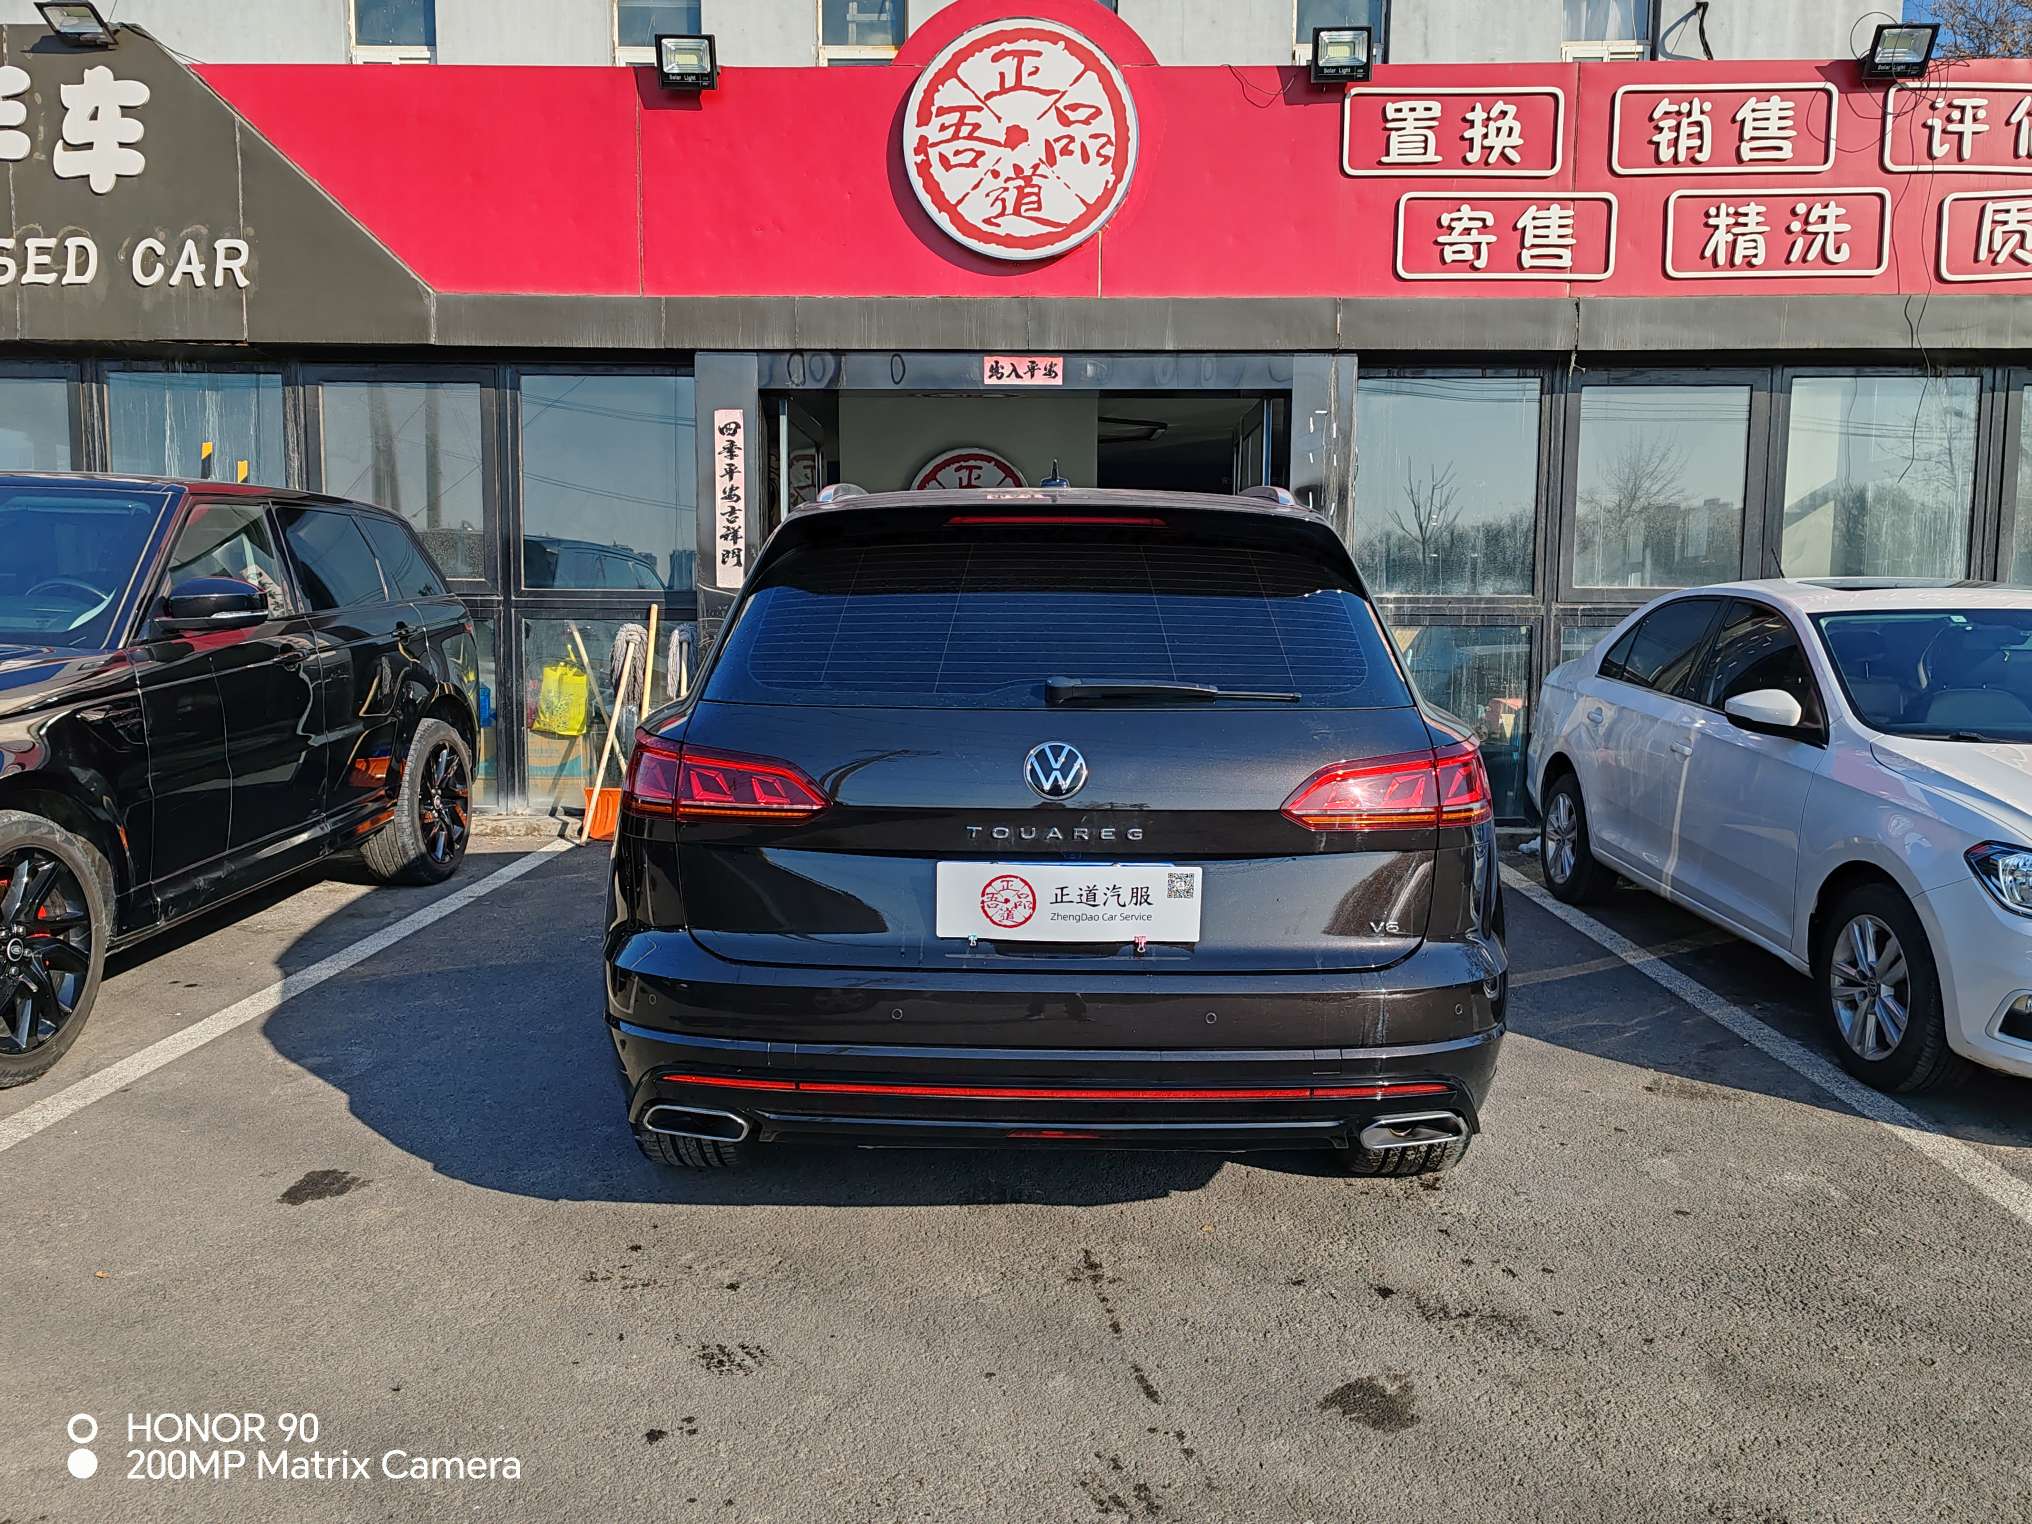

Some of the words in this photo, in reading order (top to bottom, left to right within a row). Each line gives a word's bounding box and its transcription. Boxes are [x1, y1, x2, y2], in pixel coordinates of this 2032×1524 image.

[1381, 101, 1523, 164] 置换
[1651, 96, 1797, 164] 销售
[1436, 204, 1577, 269] 寄售
[1704, 201, 1851, 267] 精洗
[132, 238, 250, 287] CAR
[966, 826, 1144, 840] TOUAREG
[1050, 884, 1154, 907] 正道汽服
[1050, 912, 1100, 923] ZhengDao
[1101, 913, 1118, 921] Car
[1119, 912, 1153, 921] Service
[1370, 921, 1399, 932] V6
